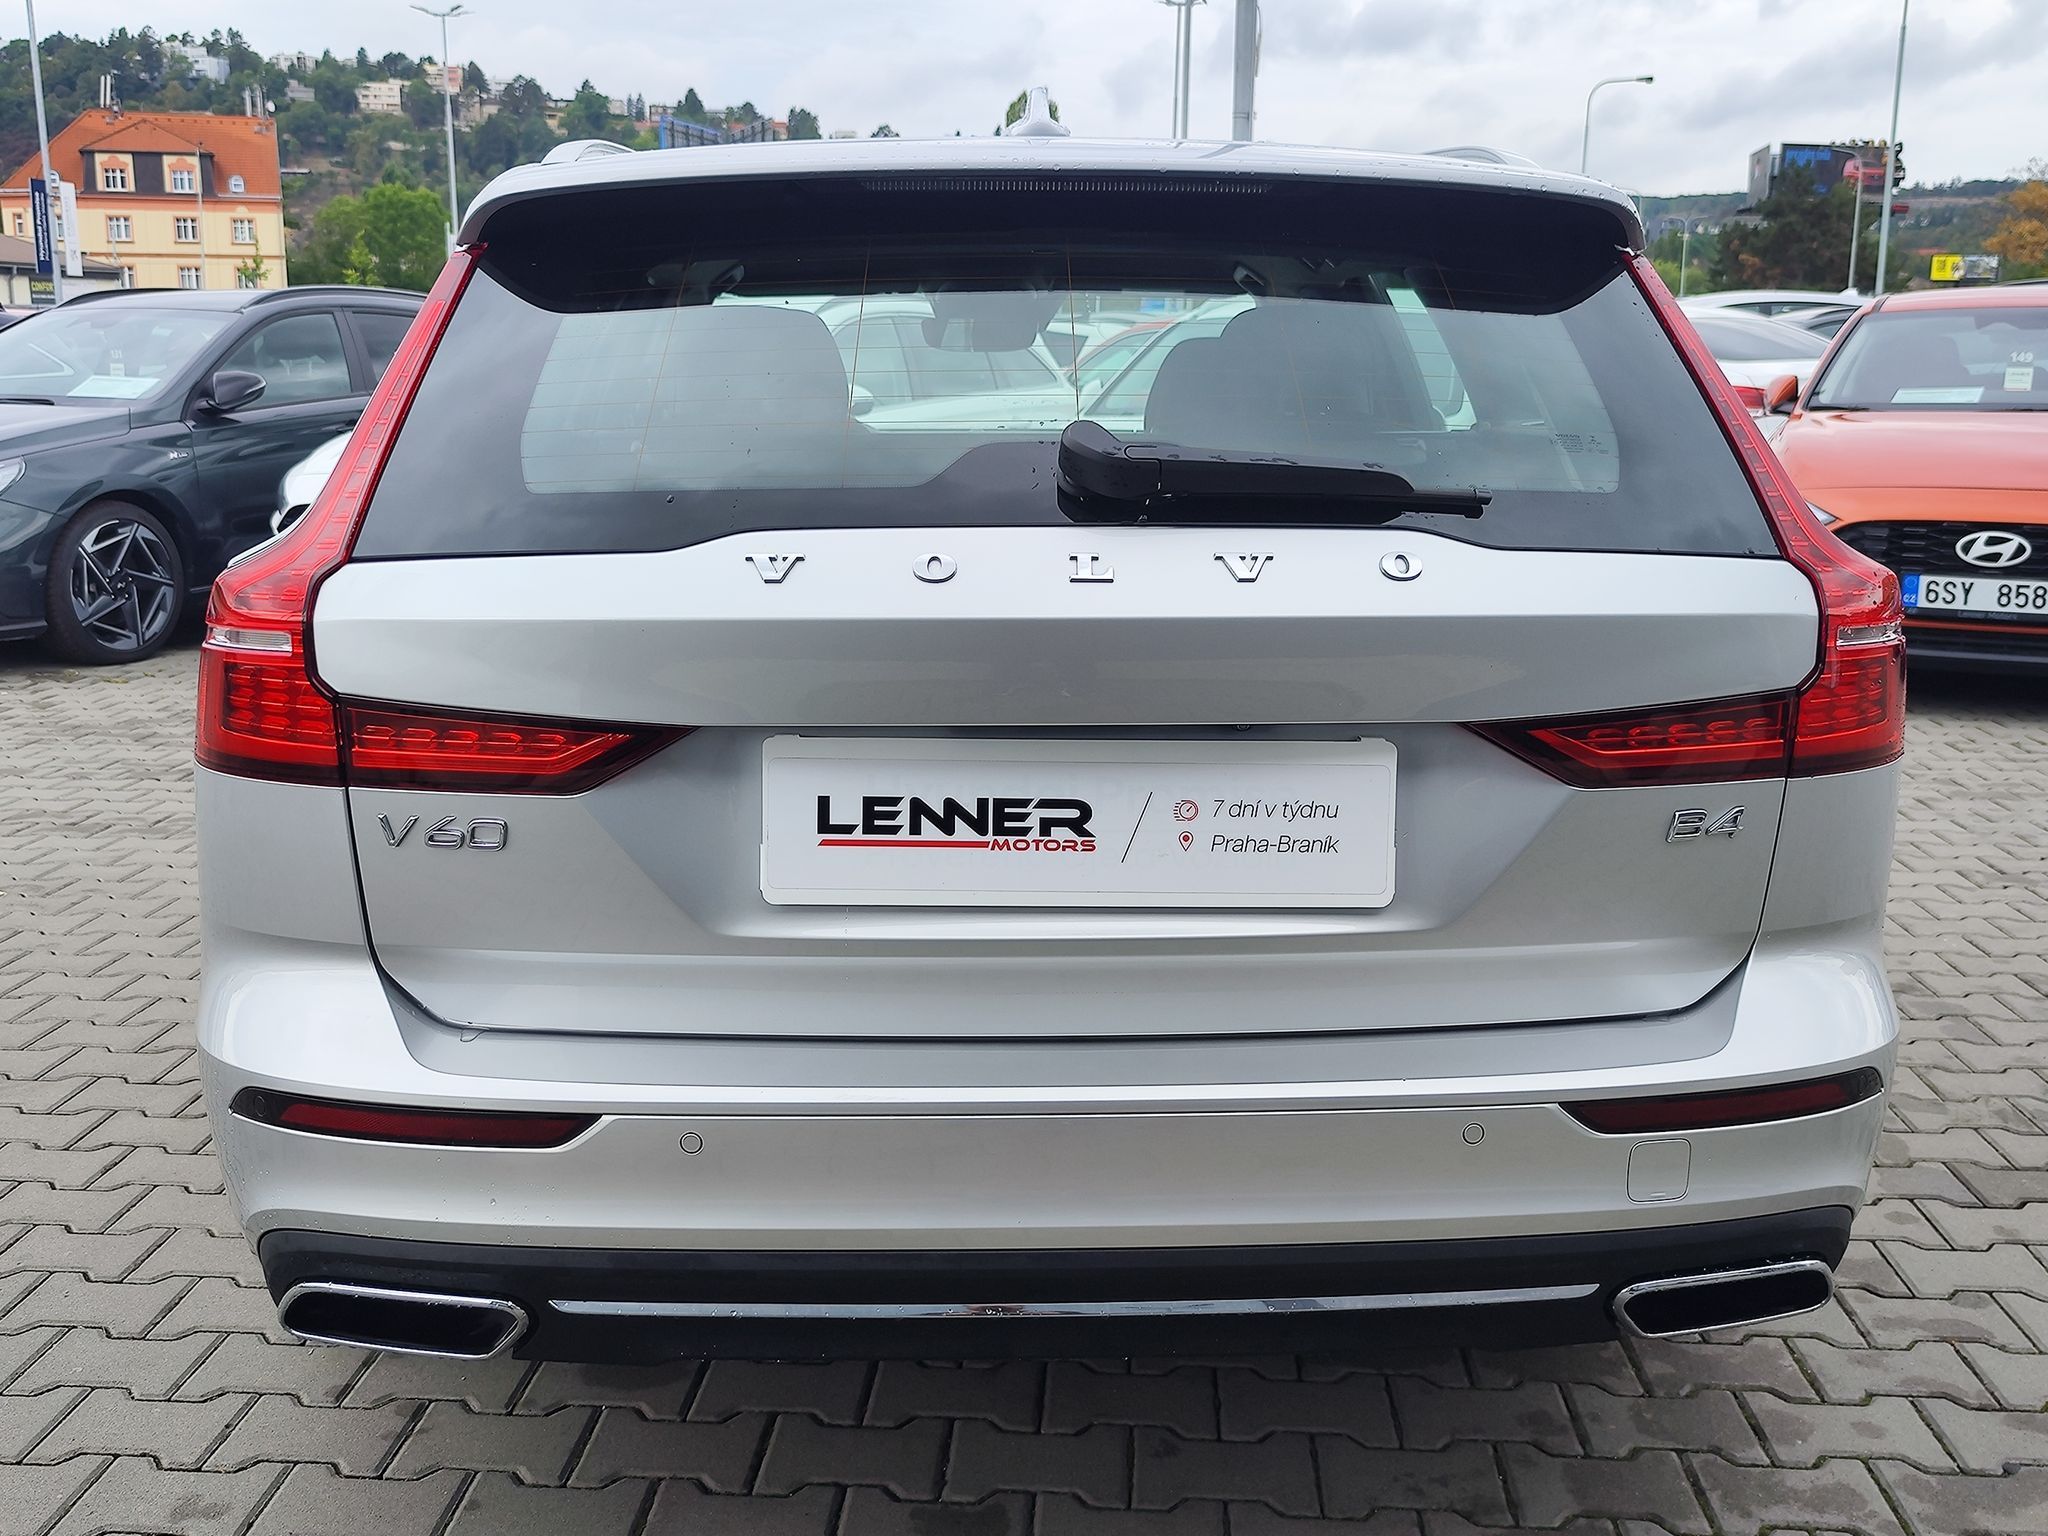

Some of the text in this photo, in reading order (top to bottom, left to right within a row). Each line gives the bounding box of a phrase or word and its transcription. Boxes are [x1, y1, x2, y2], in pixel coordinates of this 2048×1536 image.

[2010, 351, 2033, 363] 149
[745, 552, 1424, 584] VOLVO
[1925, 580, 2047, 609] 6SY 858
[816, 795, 1097, 838] LENNER
[1213, 799, 1339, 823] 7 dní v týdnu
[1665, 805, 1746, 843] B4
[377, 812, 508, 851] V60
[990, 838, 1097, 852] MOTORS
[1211, 834, 1340, 854] Praha-Braník
